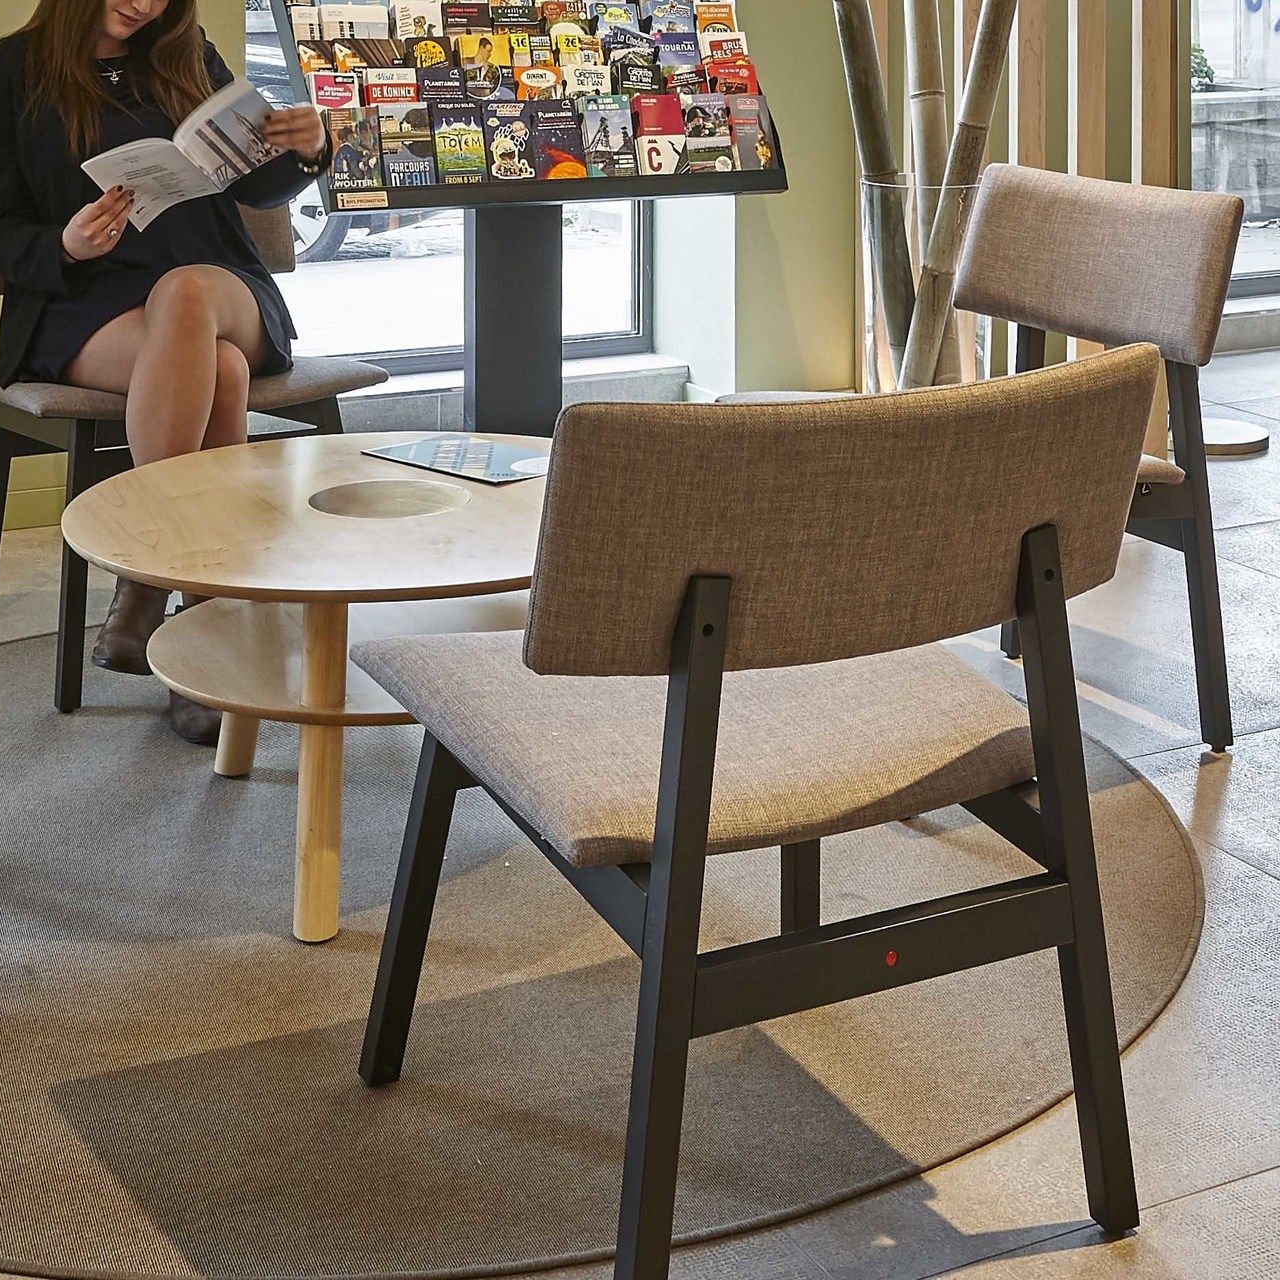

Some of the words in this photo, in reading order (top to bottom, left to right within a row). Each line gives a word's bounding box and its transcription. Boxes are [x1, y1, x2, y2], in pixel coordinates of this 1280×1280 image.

[513, 37, 528, 48] -1€
[563, 37, 577, 48] -2€
[722, 40, 743, 49] BRUS
[660, 43, 695, 52] TOURNAI
[712, 50, 732, 59] SELS
[375, 72, 395, 81] Visit
[574, 69, 605, 79] GROTTES
[424, 79, 460, 87] PLANETARIUM
[372, 87, 382, 98] DE
[383, 86, 415, 98] KONINCK
[647, 146, 663, 172] C
[389, 161, 430, 173] PARCOURS
[334, 172, 350, 181] RIK
[445, 176, 463, 184] FROM
[335, 179, 378, 188] WOUTERS
